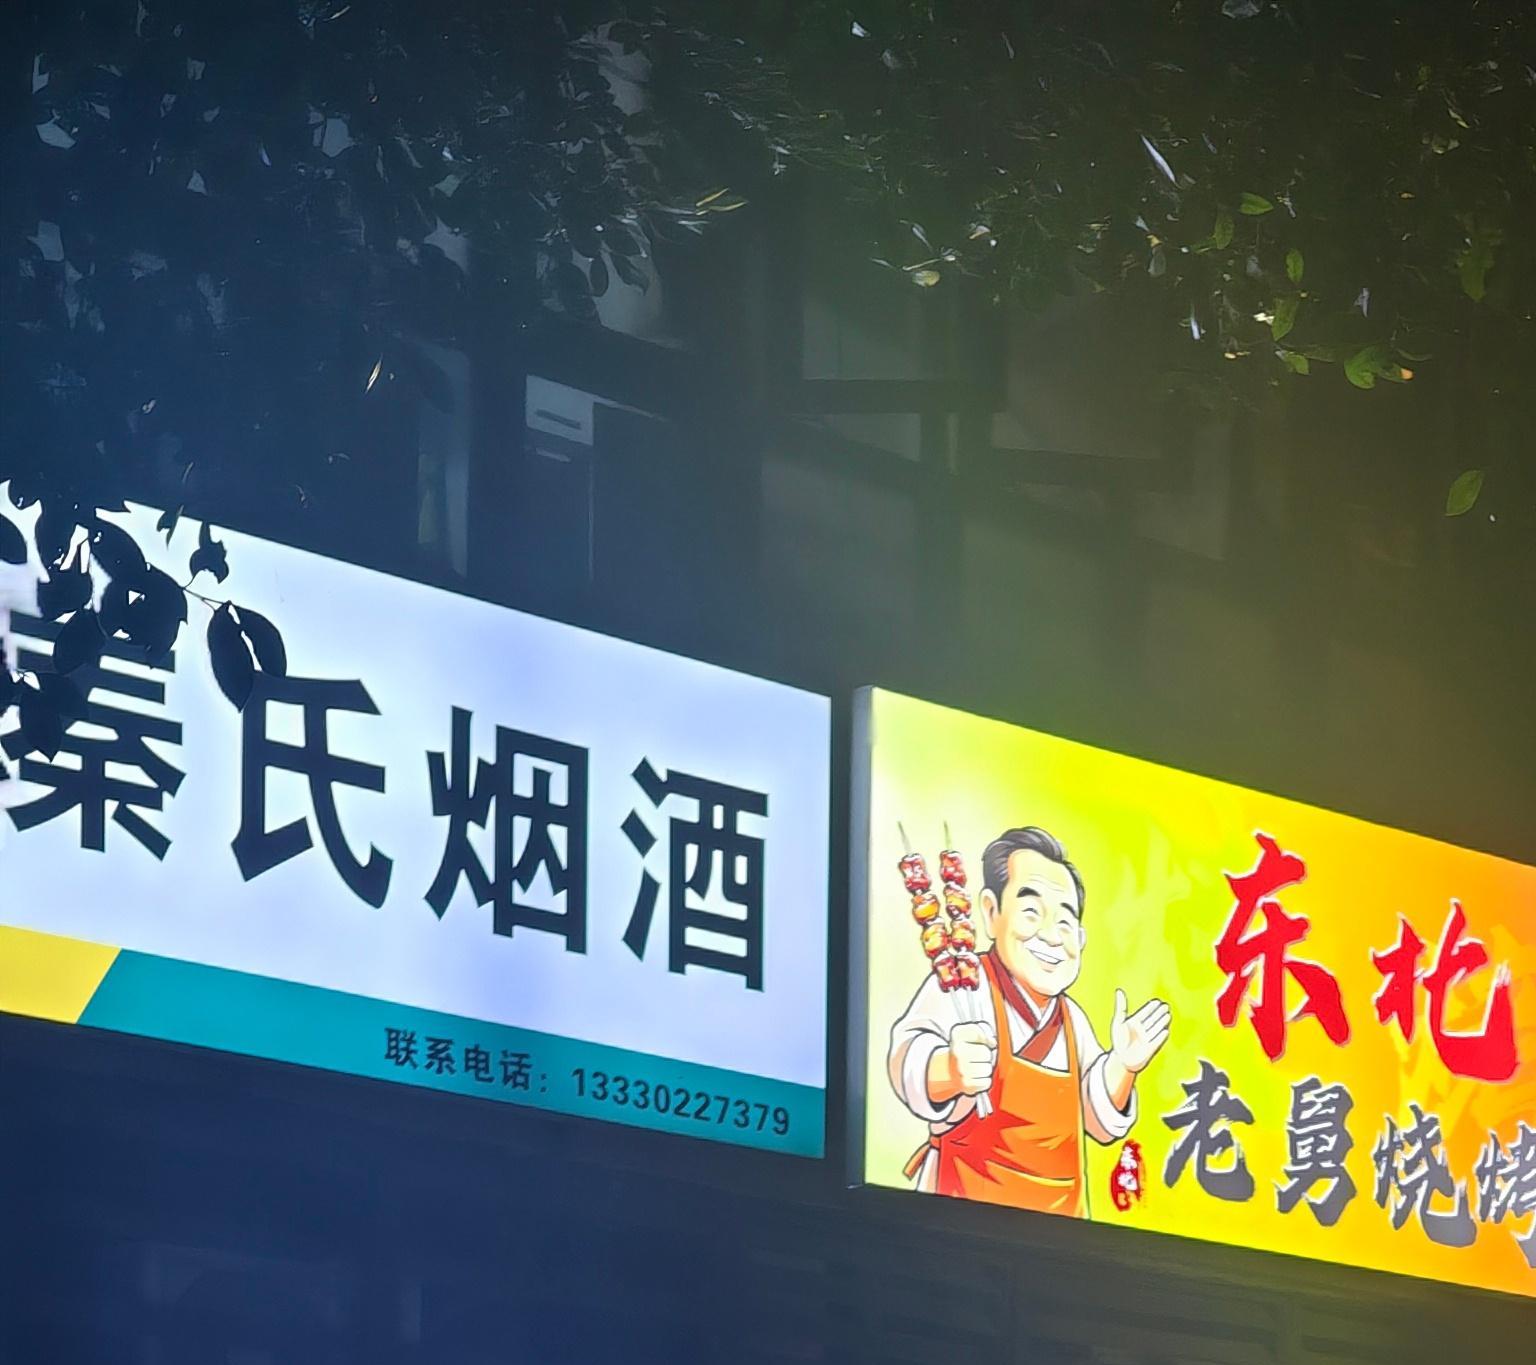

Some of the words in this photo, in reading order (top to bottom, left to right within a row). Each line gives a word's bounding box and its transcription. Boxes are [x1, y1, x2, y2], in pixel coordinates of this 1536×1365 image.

[0, 607, 769, 993] 秦氏烟酒
[1215, 831, 1521, 1083] 东北
[570, 1066, 791, 1138] 13330227379
